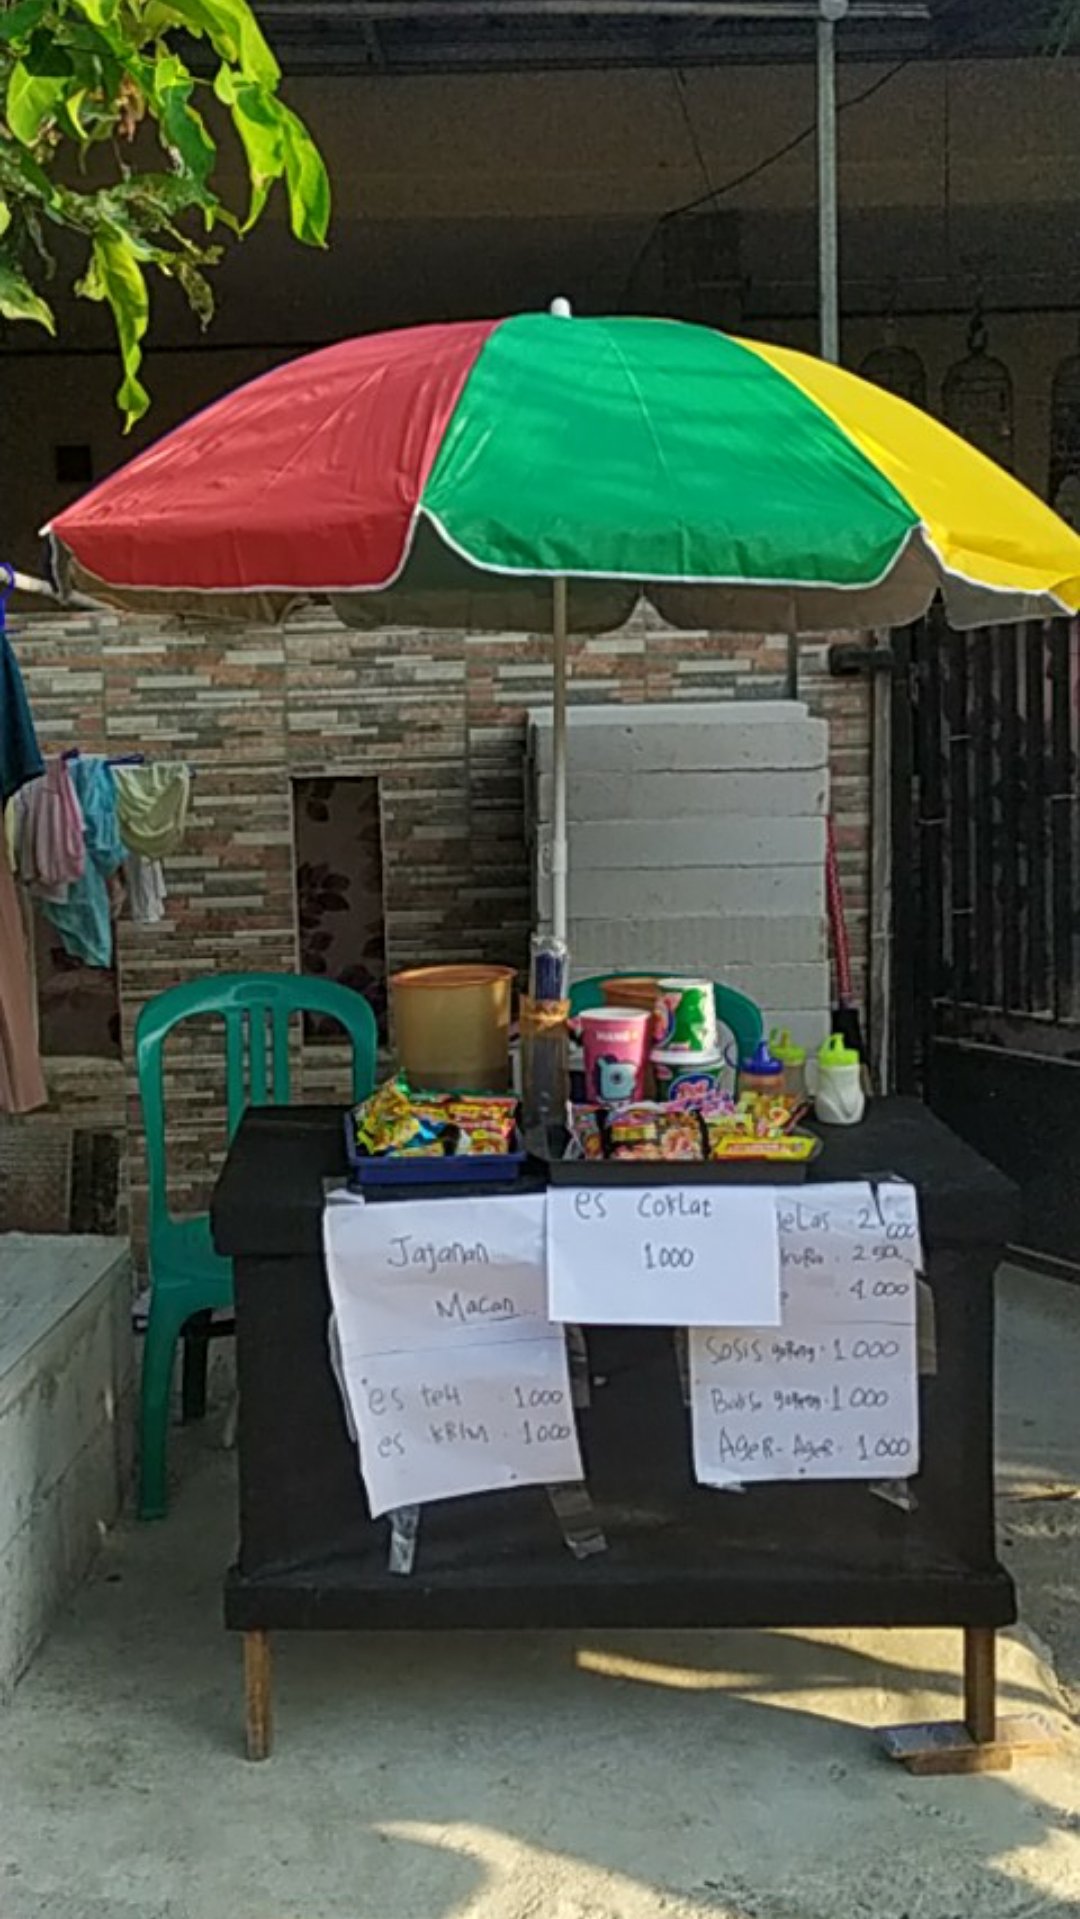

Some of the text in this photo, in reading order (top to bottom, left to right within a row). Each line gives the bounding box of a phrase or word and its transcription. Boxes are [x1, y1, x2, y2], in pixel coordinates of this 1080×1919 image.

[574, 1190, 607, 1220] es
[386, 1234, 490, 1274] Jajanan
[434, 1292, 516, 1322] Macan
[368, 1386, 405, 1416] es
[377, 1430, 406, 1459] es
